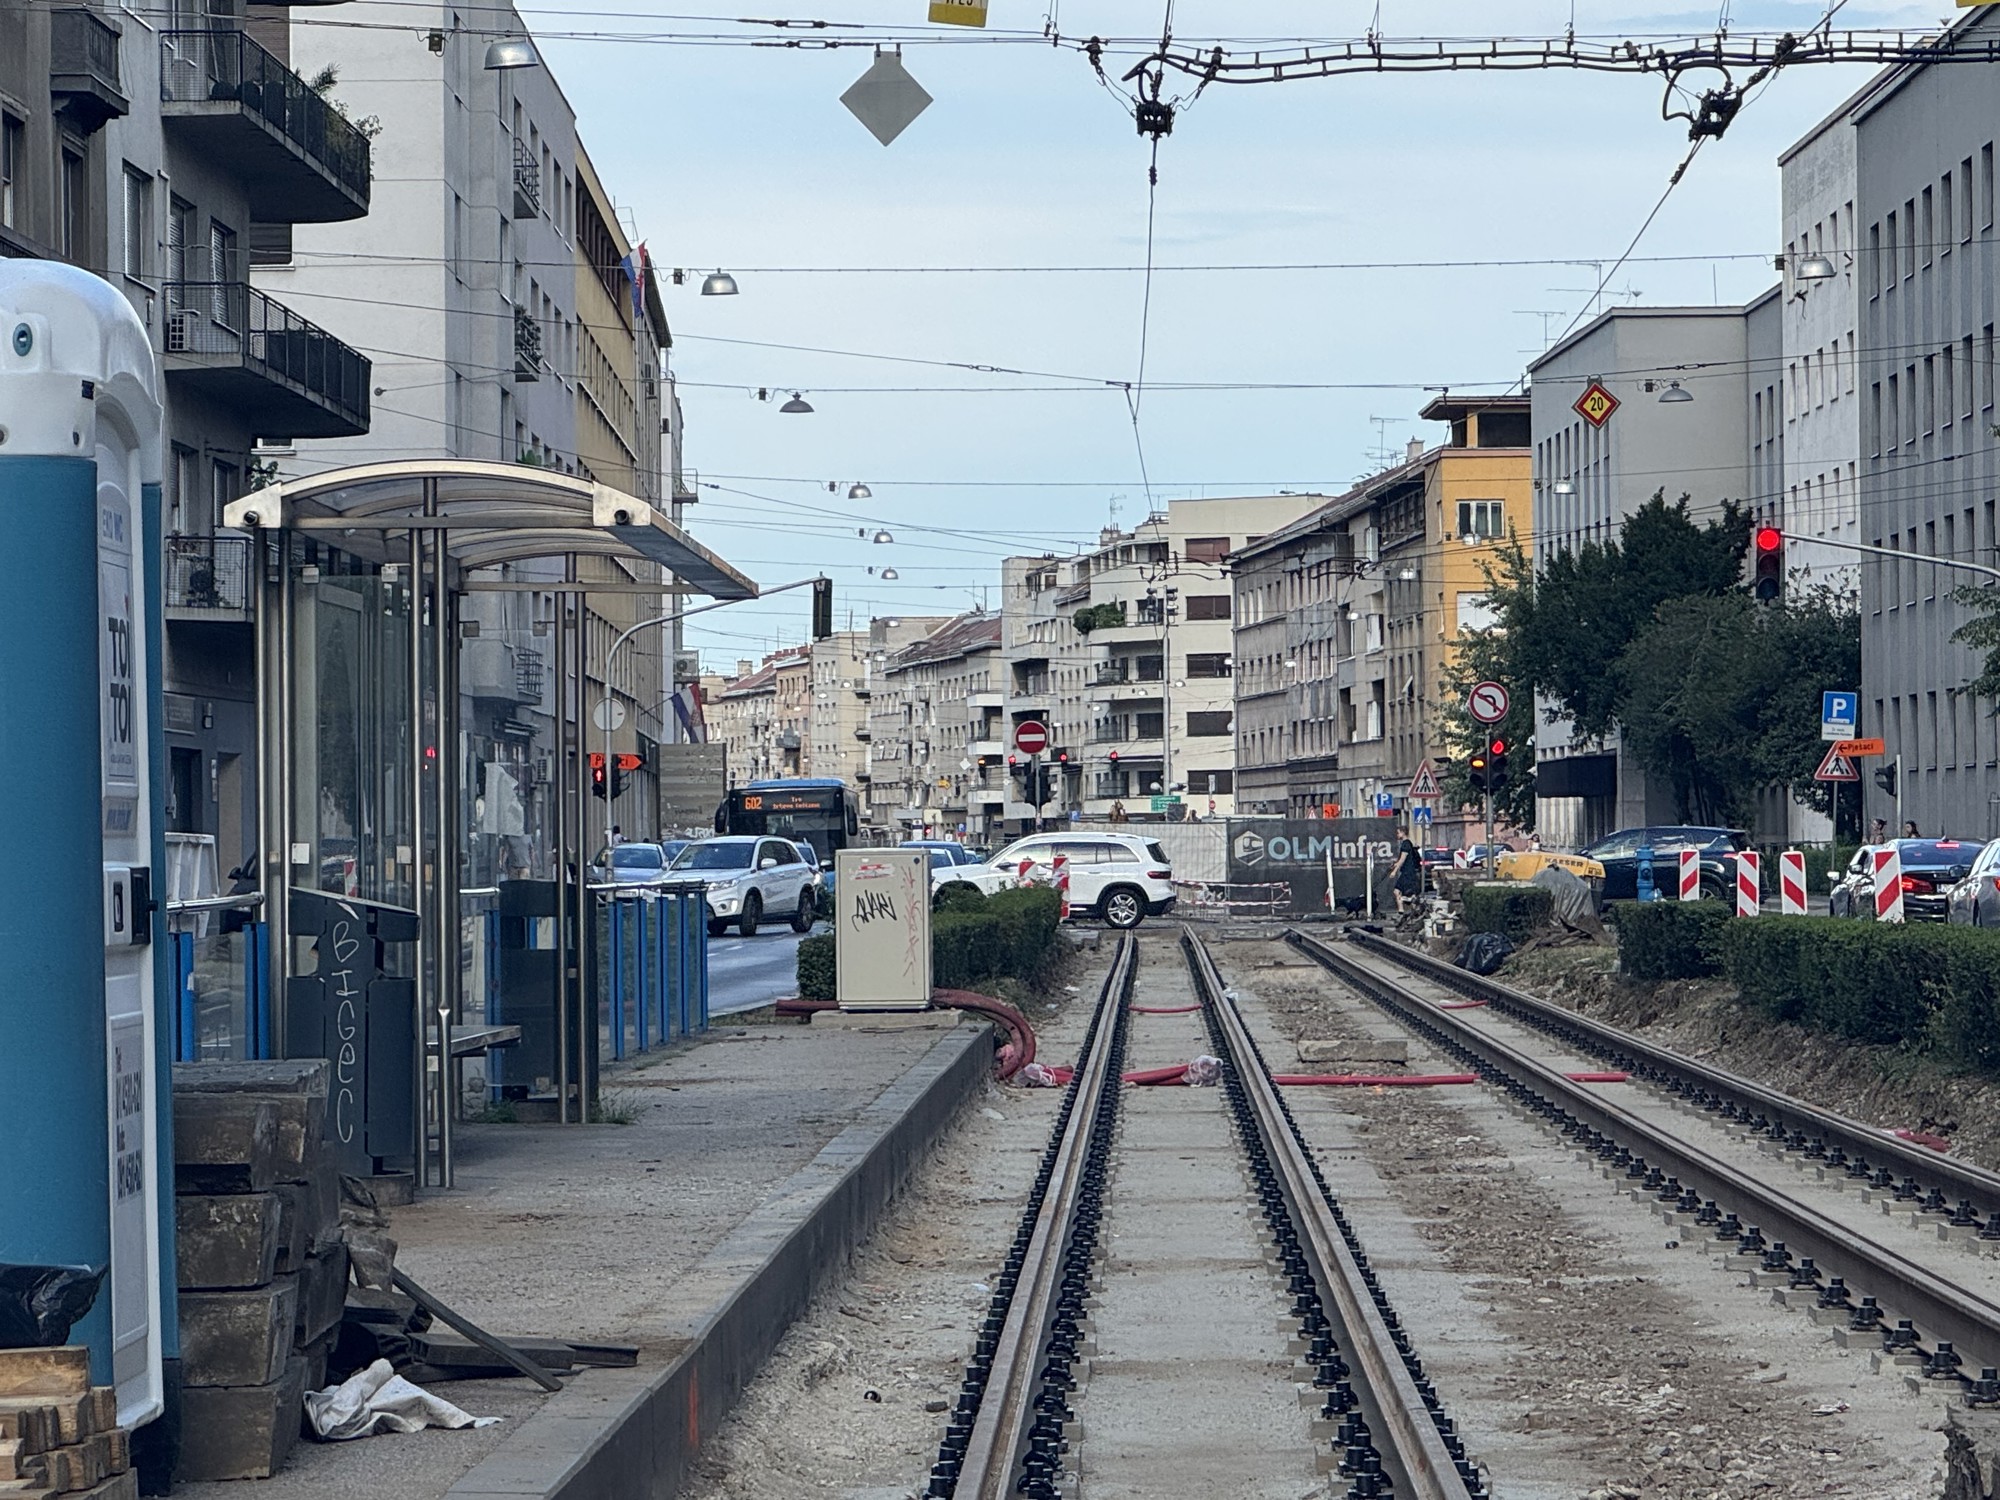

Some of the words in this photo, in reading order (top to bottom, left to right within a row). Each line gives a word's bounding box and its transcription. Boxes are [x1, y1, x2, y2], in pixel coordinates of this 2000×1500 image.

[1590, 396, 1604, 412] 20
[108, 616, 131, 679] TOI
[110, 683, 132, 744] TOI
[1832, 697, 1847, 718] P
[745, 796, 763, 810] 602
[1380, 793, 1389, 807] P
[1544, 857, 1584, 868] KAESER
